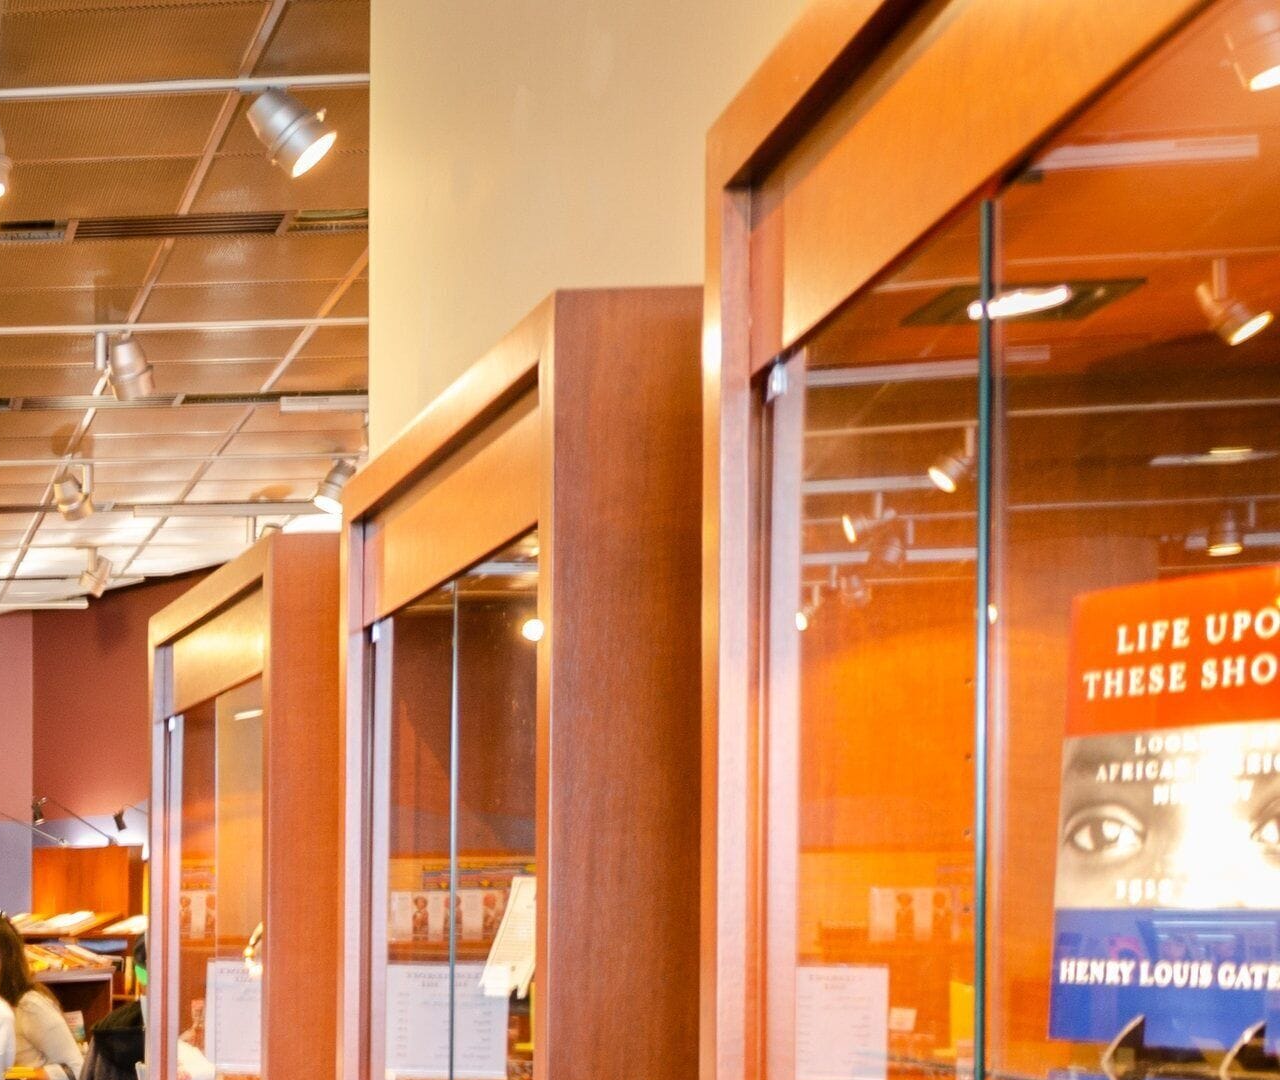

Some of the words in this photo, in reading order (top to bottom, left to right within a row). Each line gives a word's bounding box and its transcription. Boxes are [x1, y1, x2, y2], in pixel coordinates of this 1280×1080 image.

[1117, 617, 1190, 655] LIFE
[1205, 606, 1280, 645] UPO
[1083, 662, 1187, 700] THESE
[1201, 653, 1278, 690] SHO
[1059, 959, 1135, 986] HENRY
[1139, 960, 1212, 988] LOUIS
